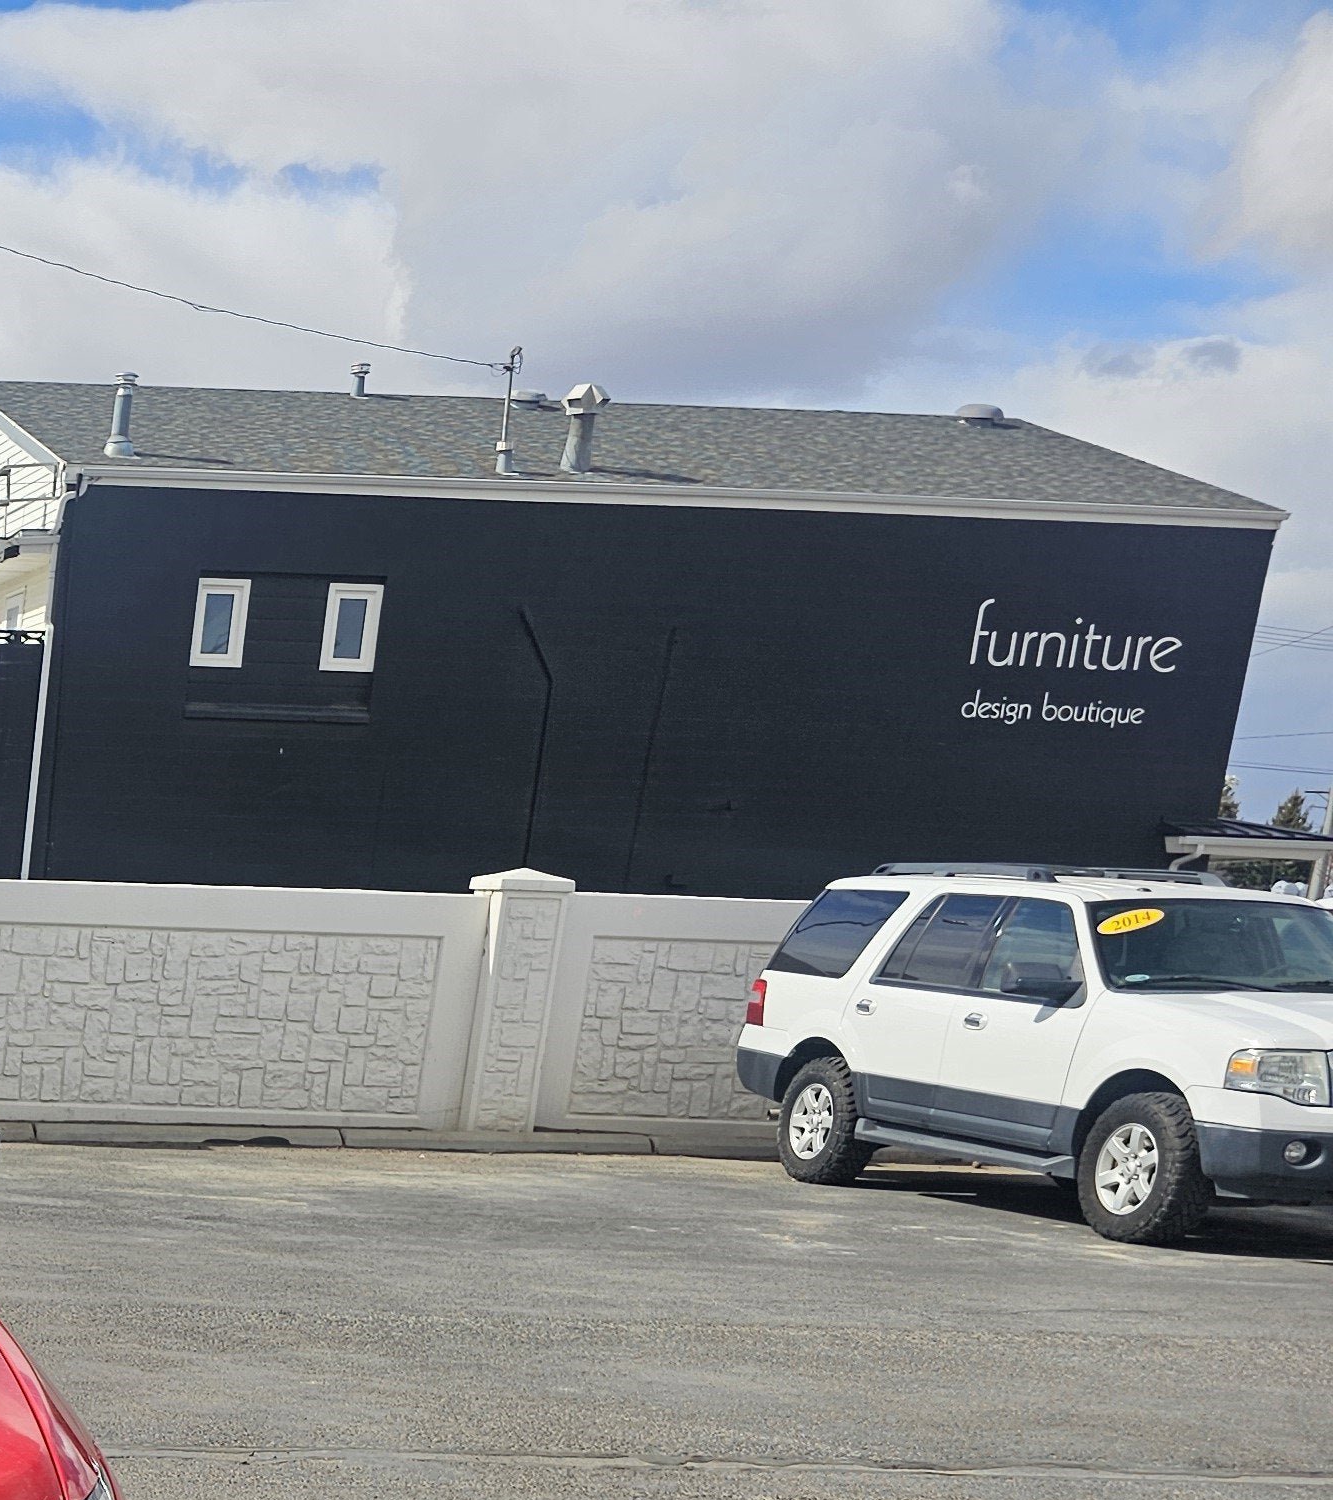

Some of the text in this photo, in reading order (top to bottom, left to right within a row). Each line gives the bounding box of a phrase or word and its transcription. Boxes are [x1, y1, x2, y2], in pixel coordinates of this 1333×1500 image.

[969, 598, 1183, 673] furniture
[960, 688, 1145, 729] design boutique
[1112, 911, 1152, 931] 2014
